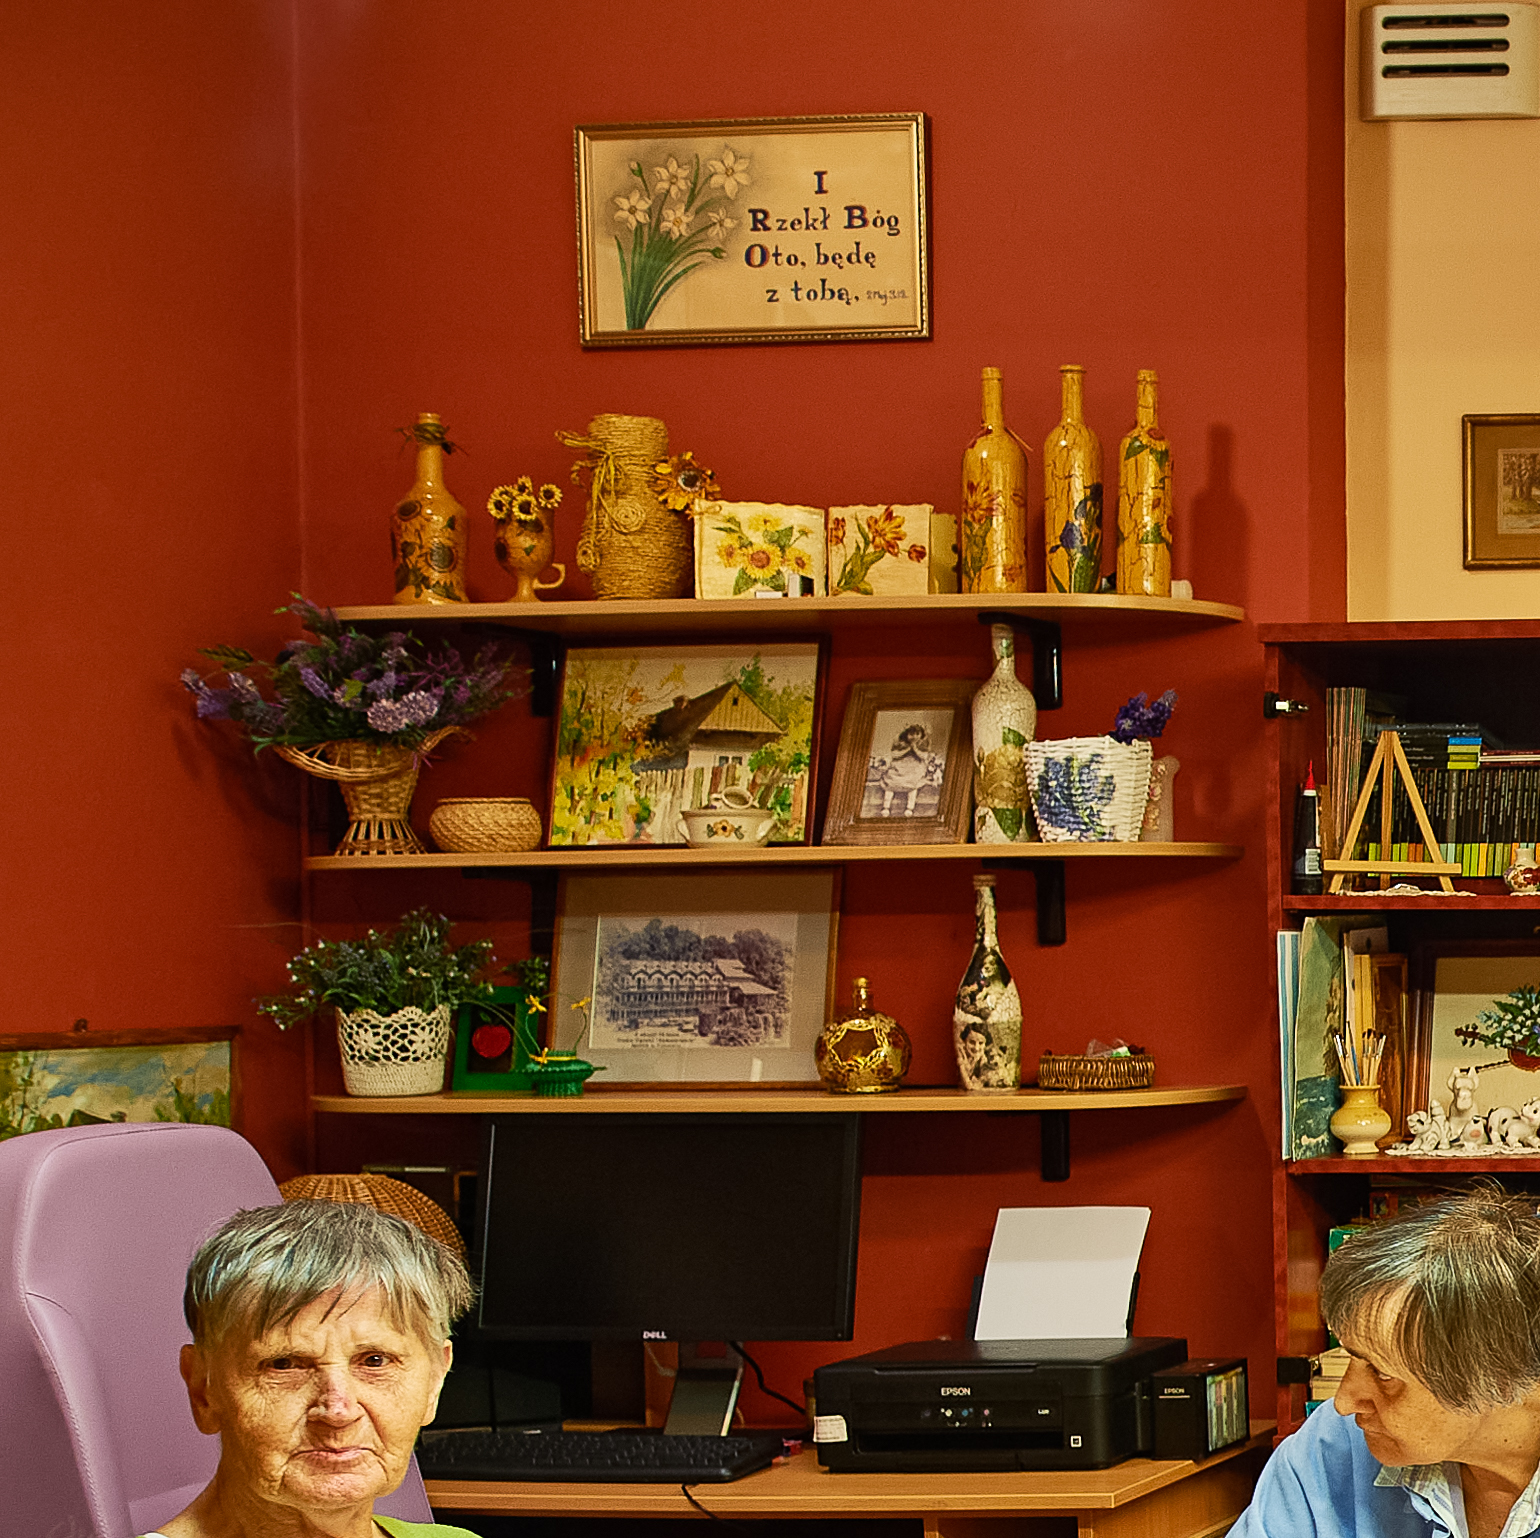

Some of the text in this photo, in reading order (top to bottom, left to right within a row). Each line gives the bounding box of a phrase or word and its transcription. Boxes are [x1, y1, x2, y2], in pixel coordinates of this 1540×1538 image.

[813, 170, 828, 195] I
[748, 204, 900, 236] Rzekł Bóg
[815, 241, 877, 270] będę
[765, 285, 780, 304] z
[643, 1330, 668, 1339] DELL
[940, 1387, 971, 1396] EPSON
